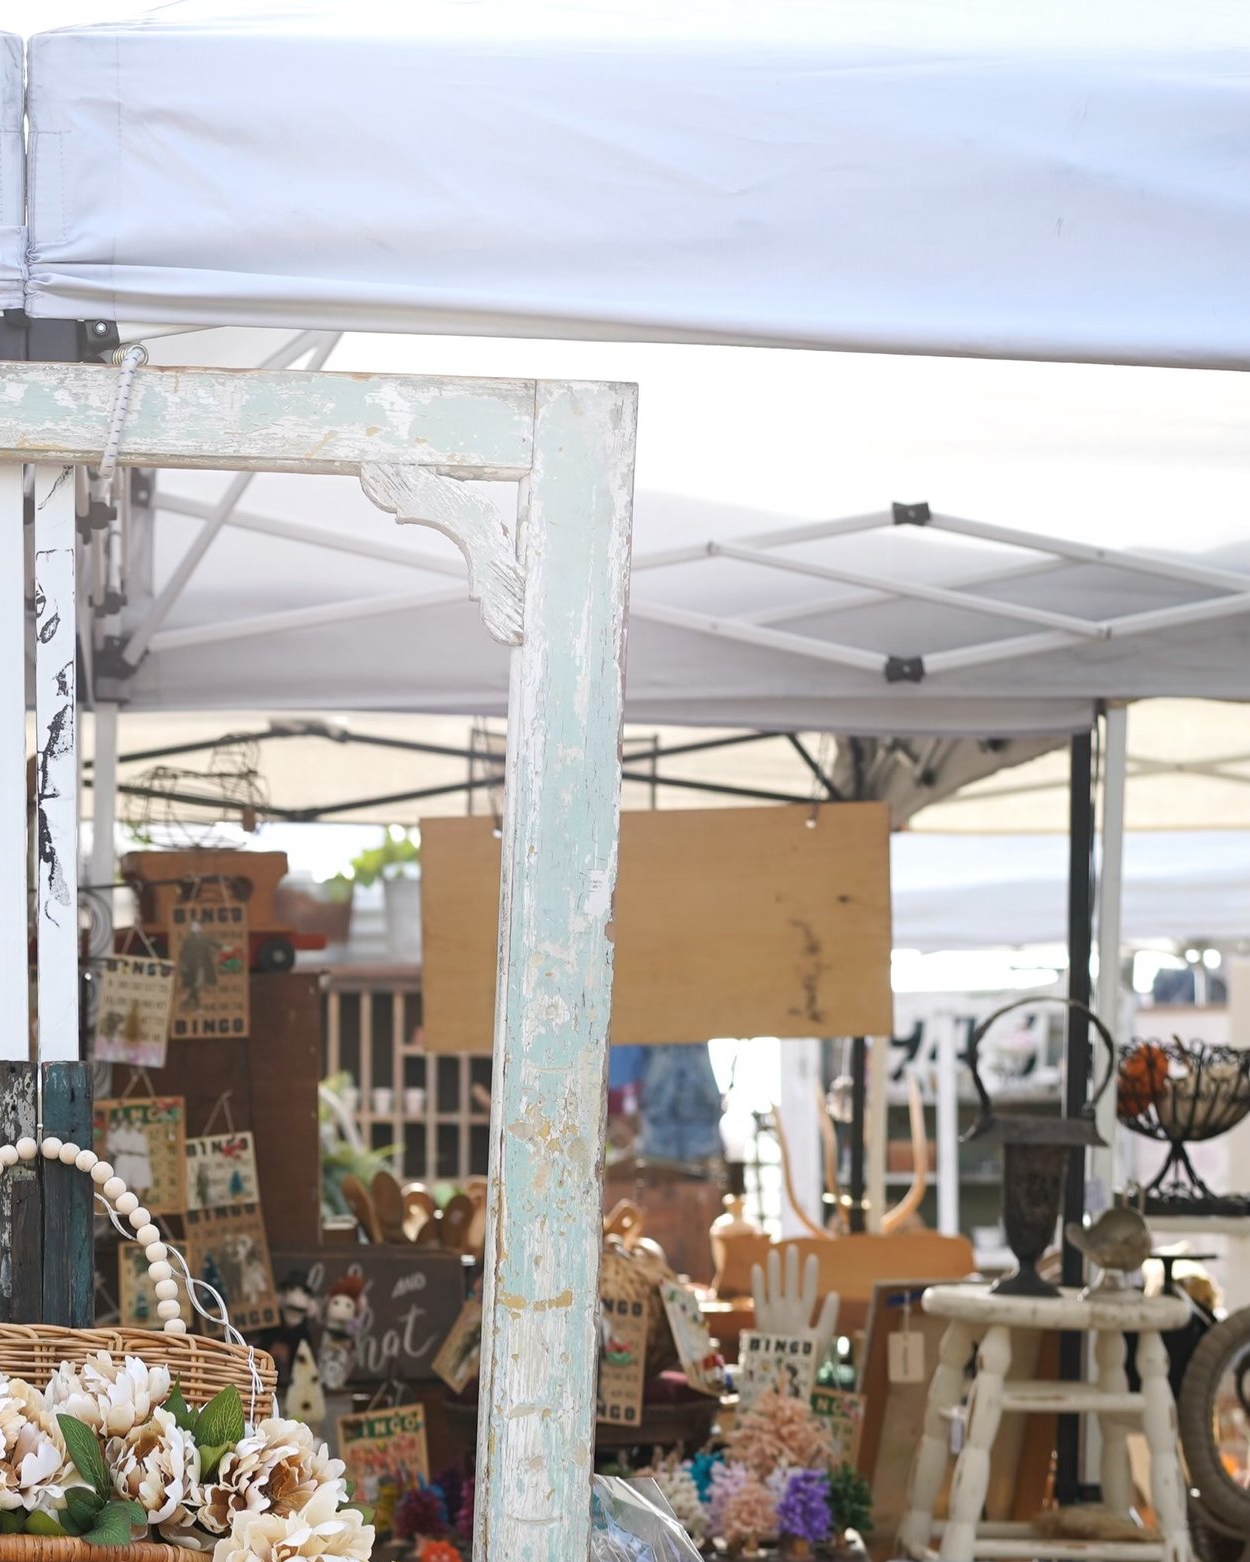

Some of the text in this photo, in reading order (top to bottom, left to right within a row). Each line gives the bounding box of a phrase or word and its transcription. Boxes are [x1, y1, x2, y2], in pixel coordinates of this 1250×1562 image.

[173, 907, 243, 924] BINGO
[174, 1018, 244, 1035] BINGO
[391, 1271, 427, 1298] AND
[749, 1338, 813, 1355] BINGO
